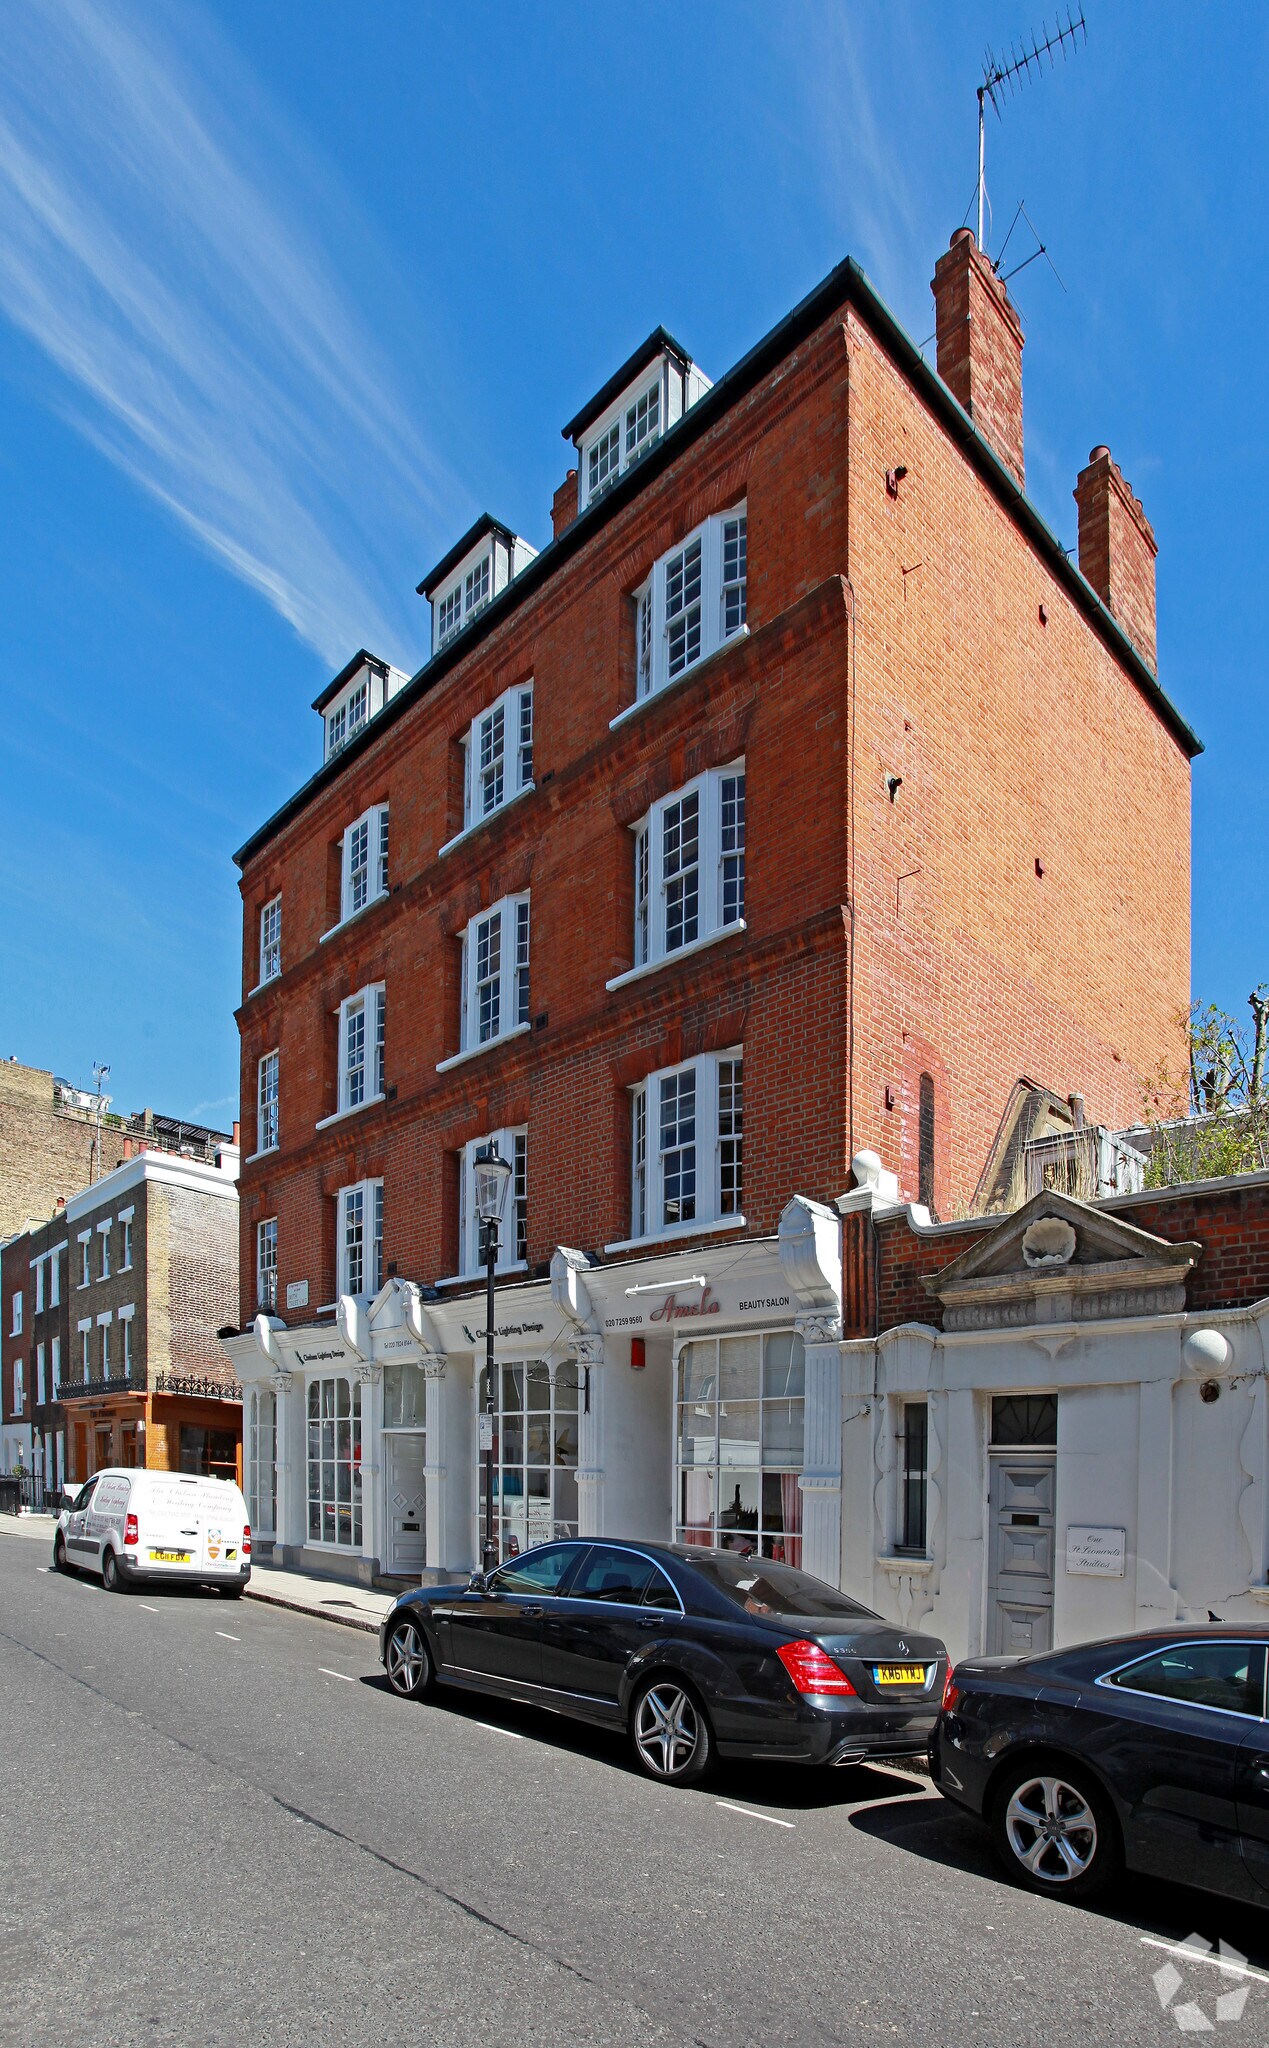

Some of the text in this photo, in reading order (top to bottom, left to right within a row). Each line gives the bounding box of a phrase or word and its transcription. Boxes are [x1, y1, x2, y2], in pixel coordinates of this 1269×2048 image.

[739, 1297, 790, 1310] BEAUTY SALON
[605, 1315, 642, 1328] 020 7259 9560
[475, 1322, 544, 1338] Chea Lighting Design
[317, 1351, 333, 1361] Lighting
[331, 1349, 346, 1359] Design
[1087, 1535, 1103, 1543] One
[1076, 1557, 1110, 1568] Studios
[881, 1666, 920, 1681] KM61 YMJ
